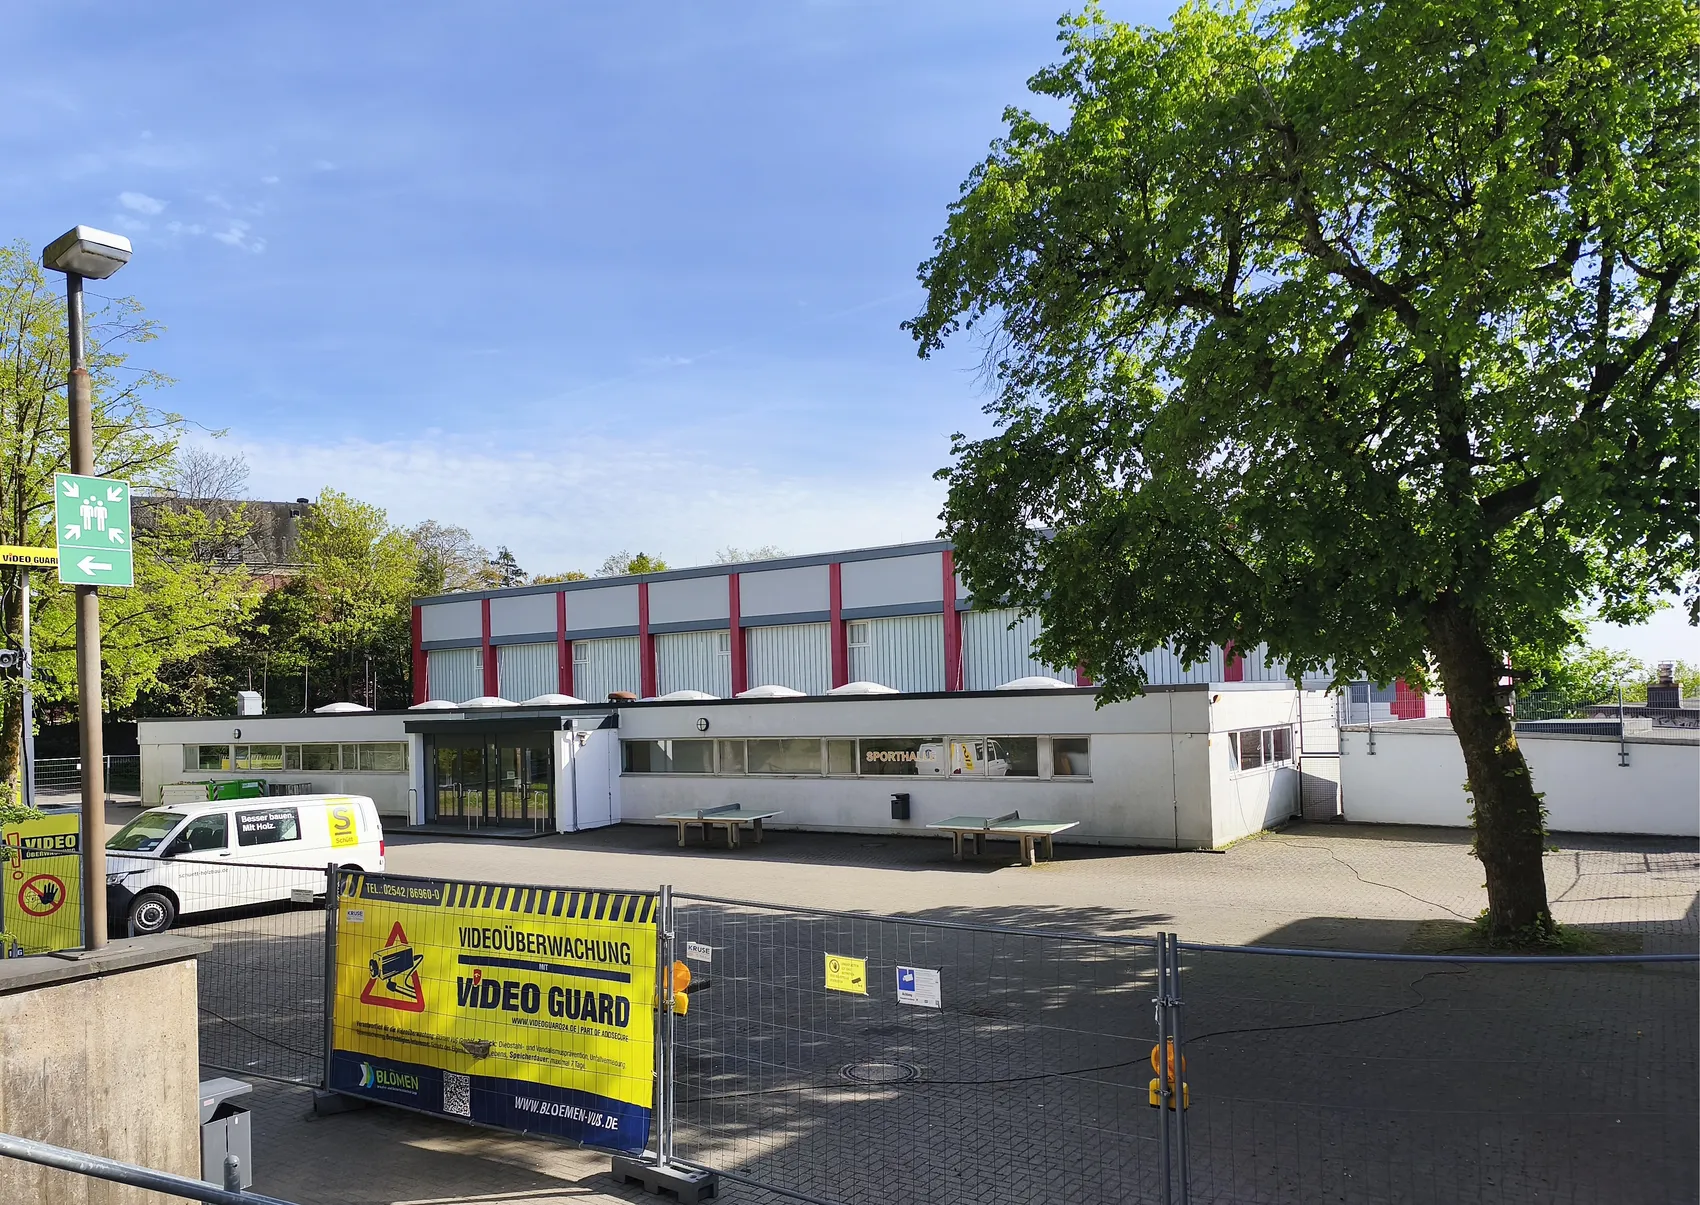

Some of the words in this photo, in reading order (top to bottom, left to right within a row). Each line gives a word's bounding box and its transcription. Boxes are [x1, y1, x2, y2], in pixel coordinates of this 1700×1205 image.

[241, 815, 268, 823] Besser
[269, 812, 295, 820] bauen.
[242, 824, 256, 832] Mit
[256, 822, 276, 831] Holz.
[25, 834, 76, 850] VIDEO
[459, 925, 631, 965] VIDEOÜBERWACHUNG
[688, 945, 710, 955] KRUSE
[538, 963, 549, 971] MIT
[548, 985, 631, 1028] GUARD
[511, 1017, 577, 1033] WWW.VIDEOGUARD24.DE
[580, 1026, 593, 1036] PART
[594, 1029, 601, 1037] OF
[601, 1031, 629, 1043] ADDSECURE
[509, 1051, 550, 1064] Speicherdauer:
[514, 1096, 619, 1130] WWW.BLOEMEN-VUS.DE
